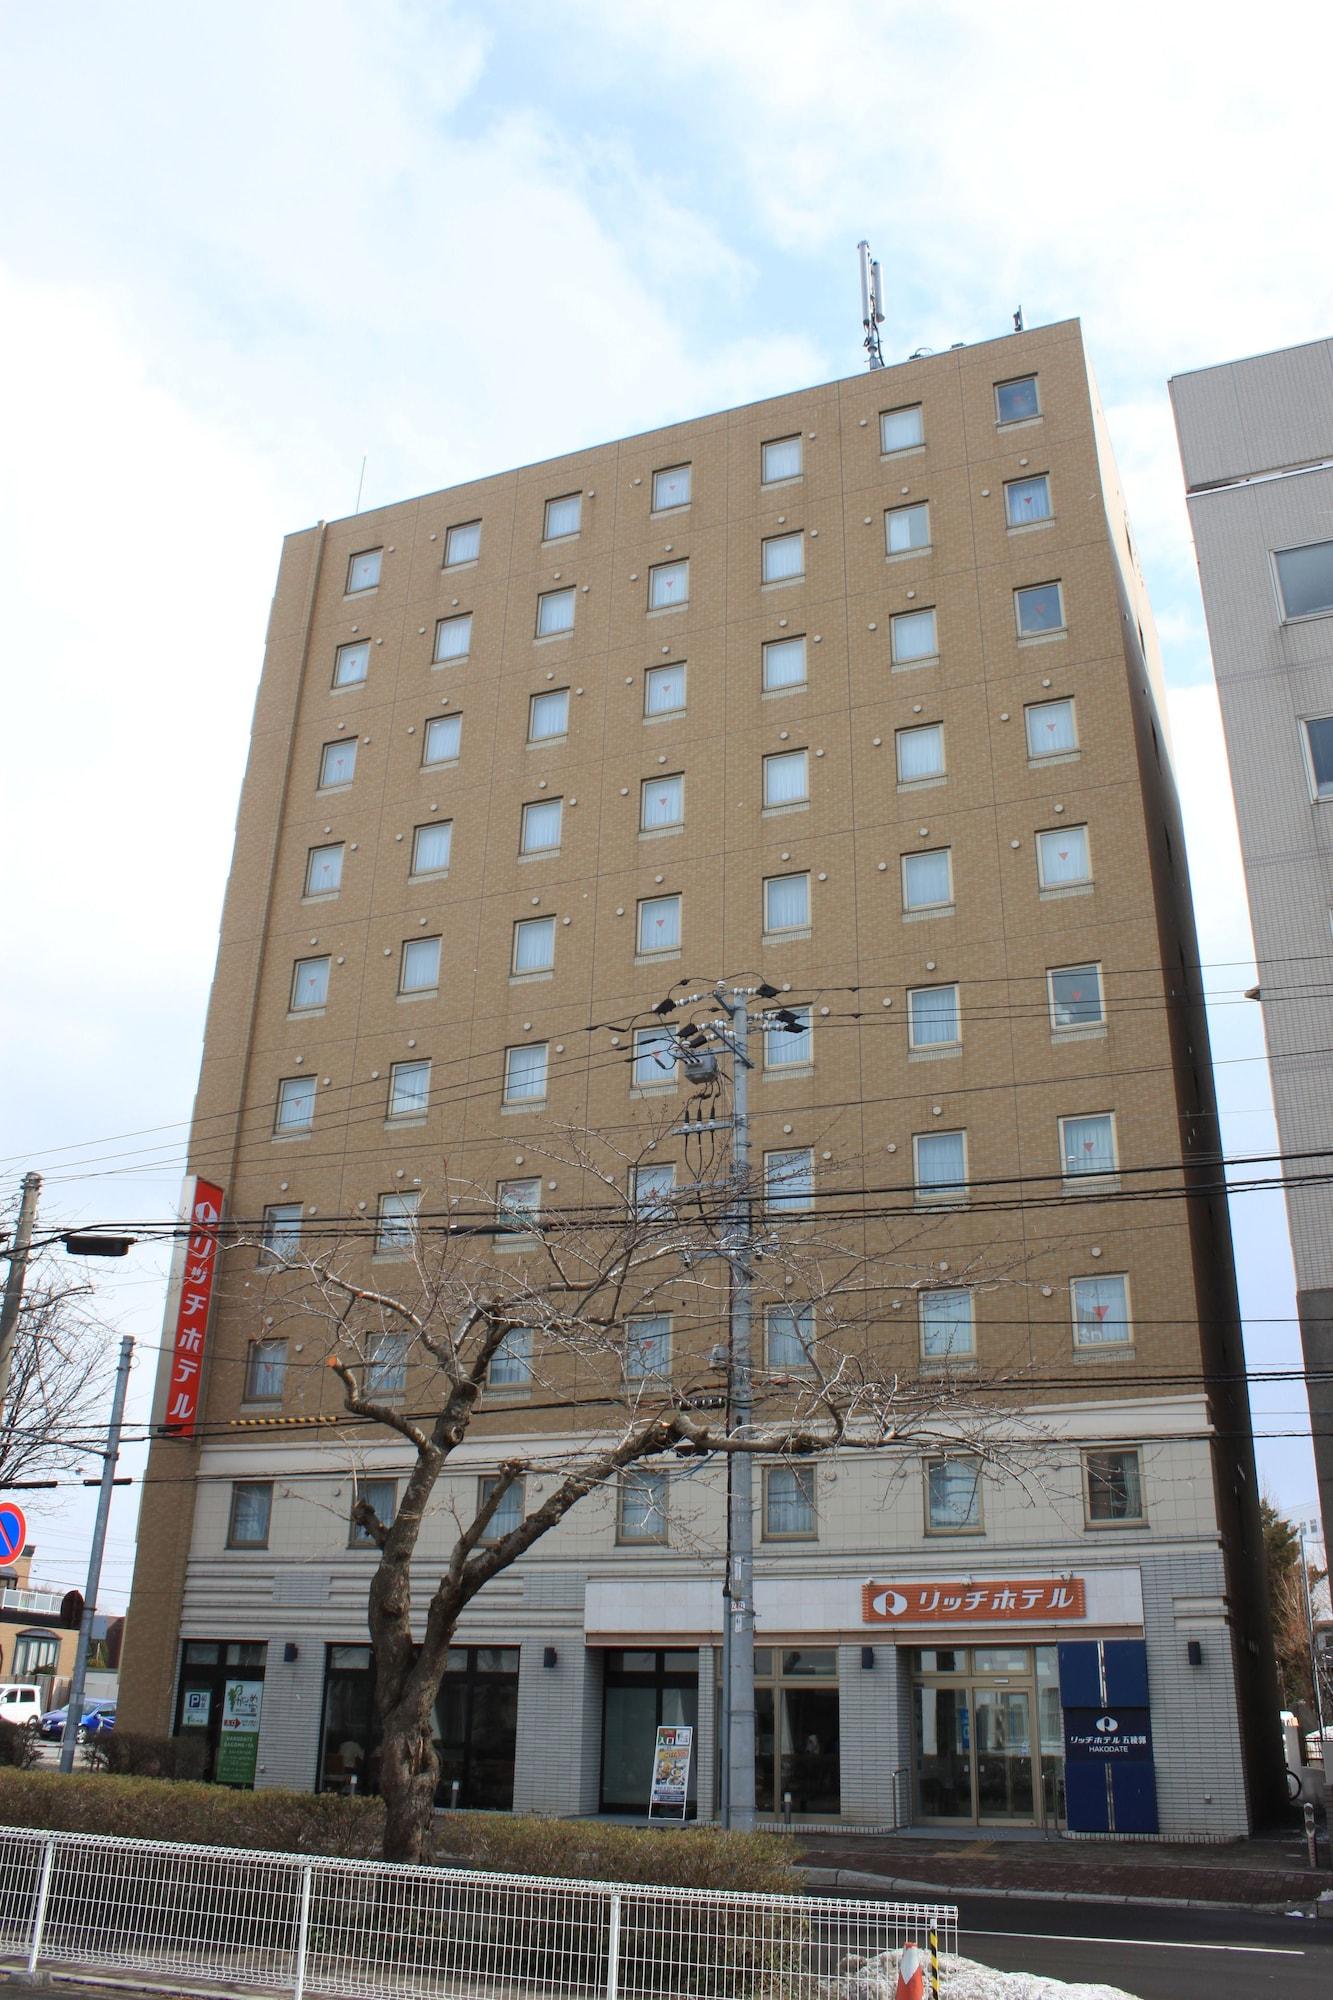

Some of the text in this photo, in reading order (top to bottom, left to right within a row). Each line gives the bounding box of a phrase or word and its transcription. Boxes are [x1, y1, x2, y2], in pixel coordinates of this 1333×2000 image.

[169, 1238, 212, 1418] リッチホテル
[919, 1587, 1074, 1612] リッチホテル
[1070, 1736, 1120, 1744] リッチホテル
